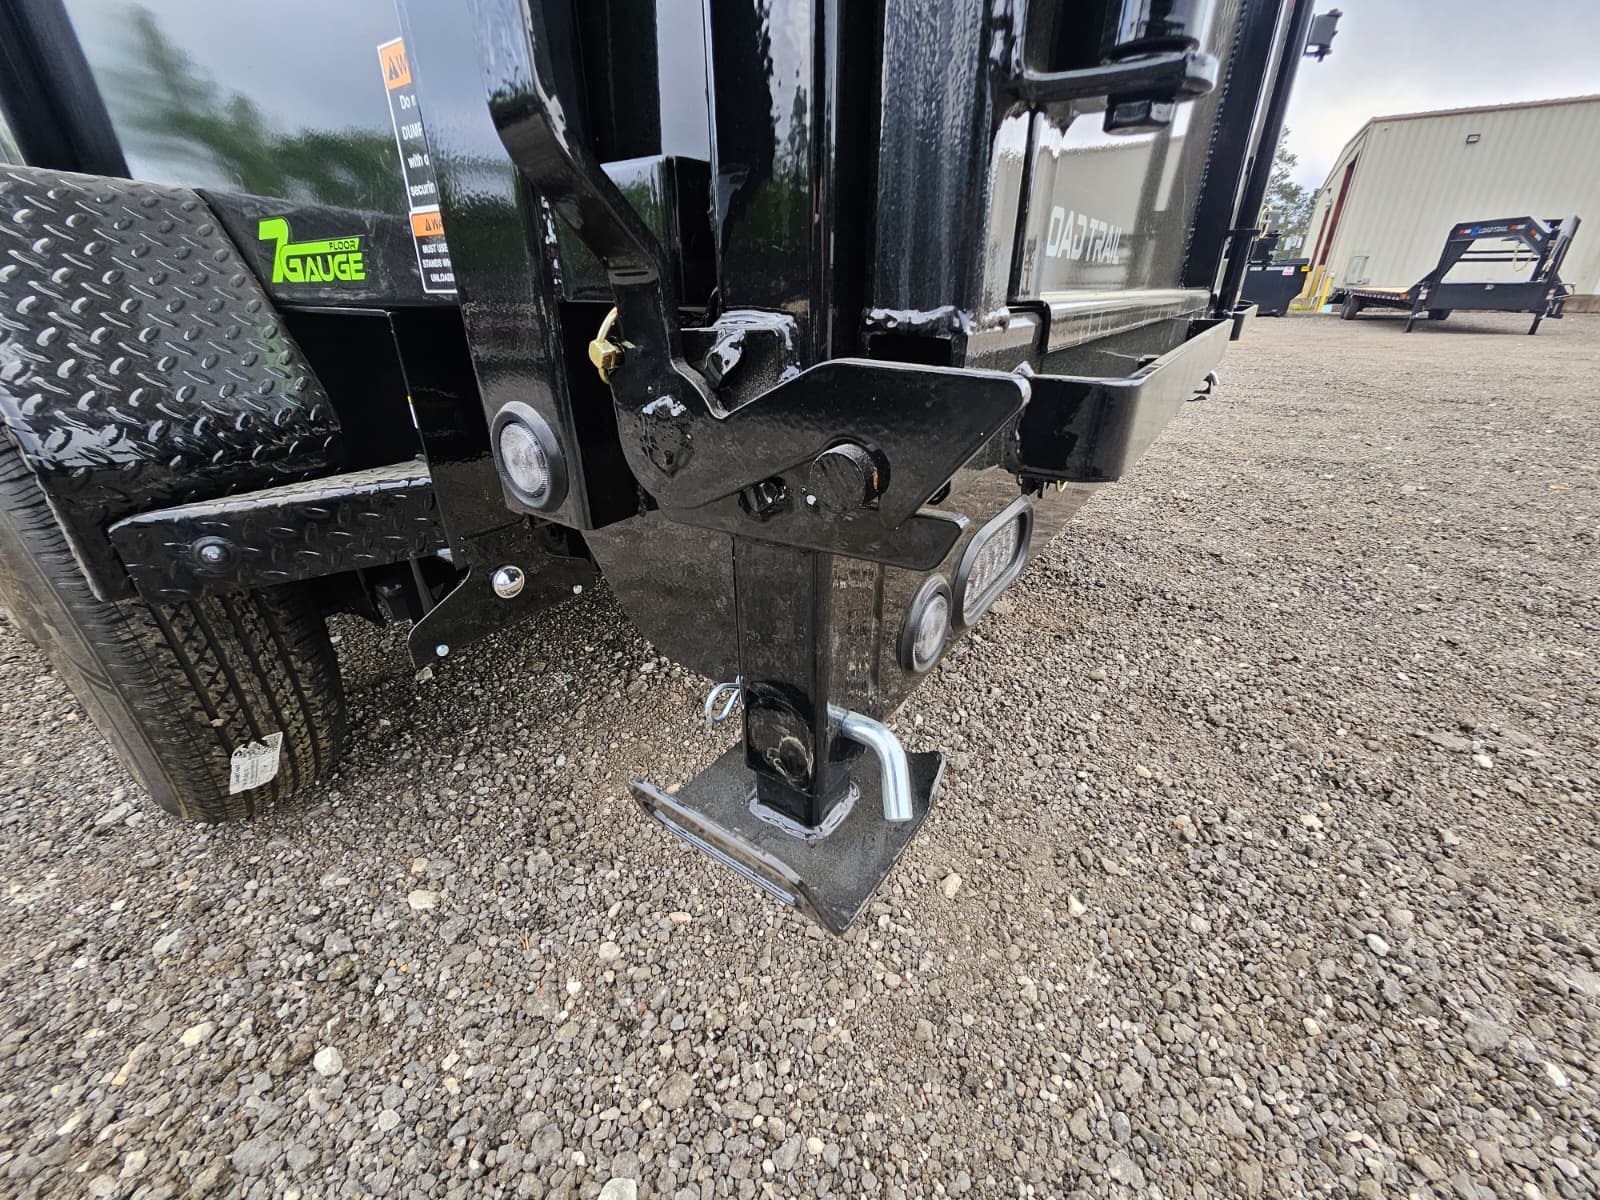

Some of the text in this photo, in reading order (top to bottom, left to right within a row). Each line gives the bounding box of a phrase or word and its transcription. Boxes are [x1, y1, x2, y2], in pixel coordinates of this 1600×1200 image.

[400, 94, 411, 110] Do
[408, 153, 423, 168] with
[259, 216, 366, 283] 7 GAUGE
[328, 241, 356, 250] FLOOR
